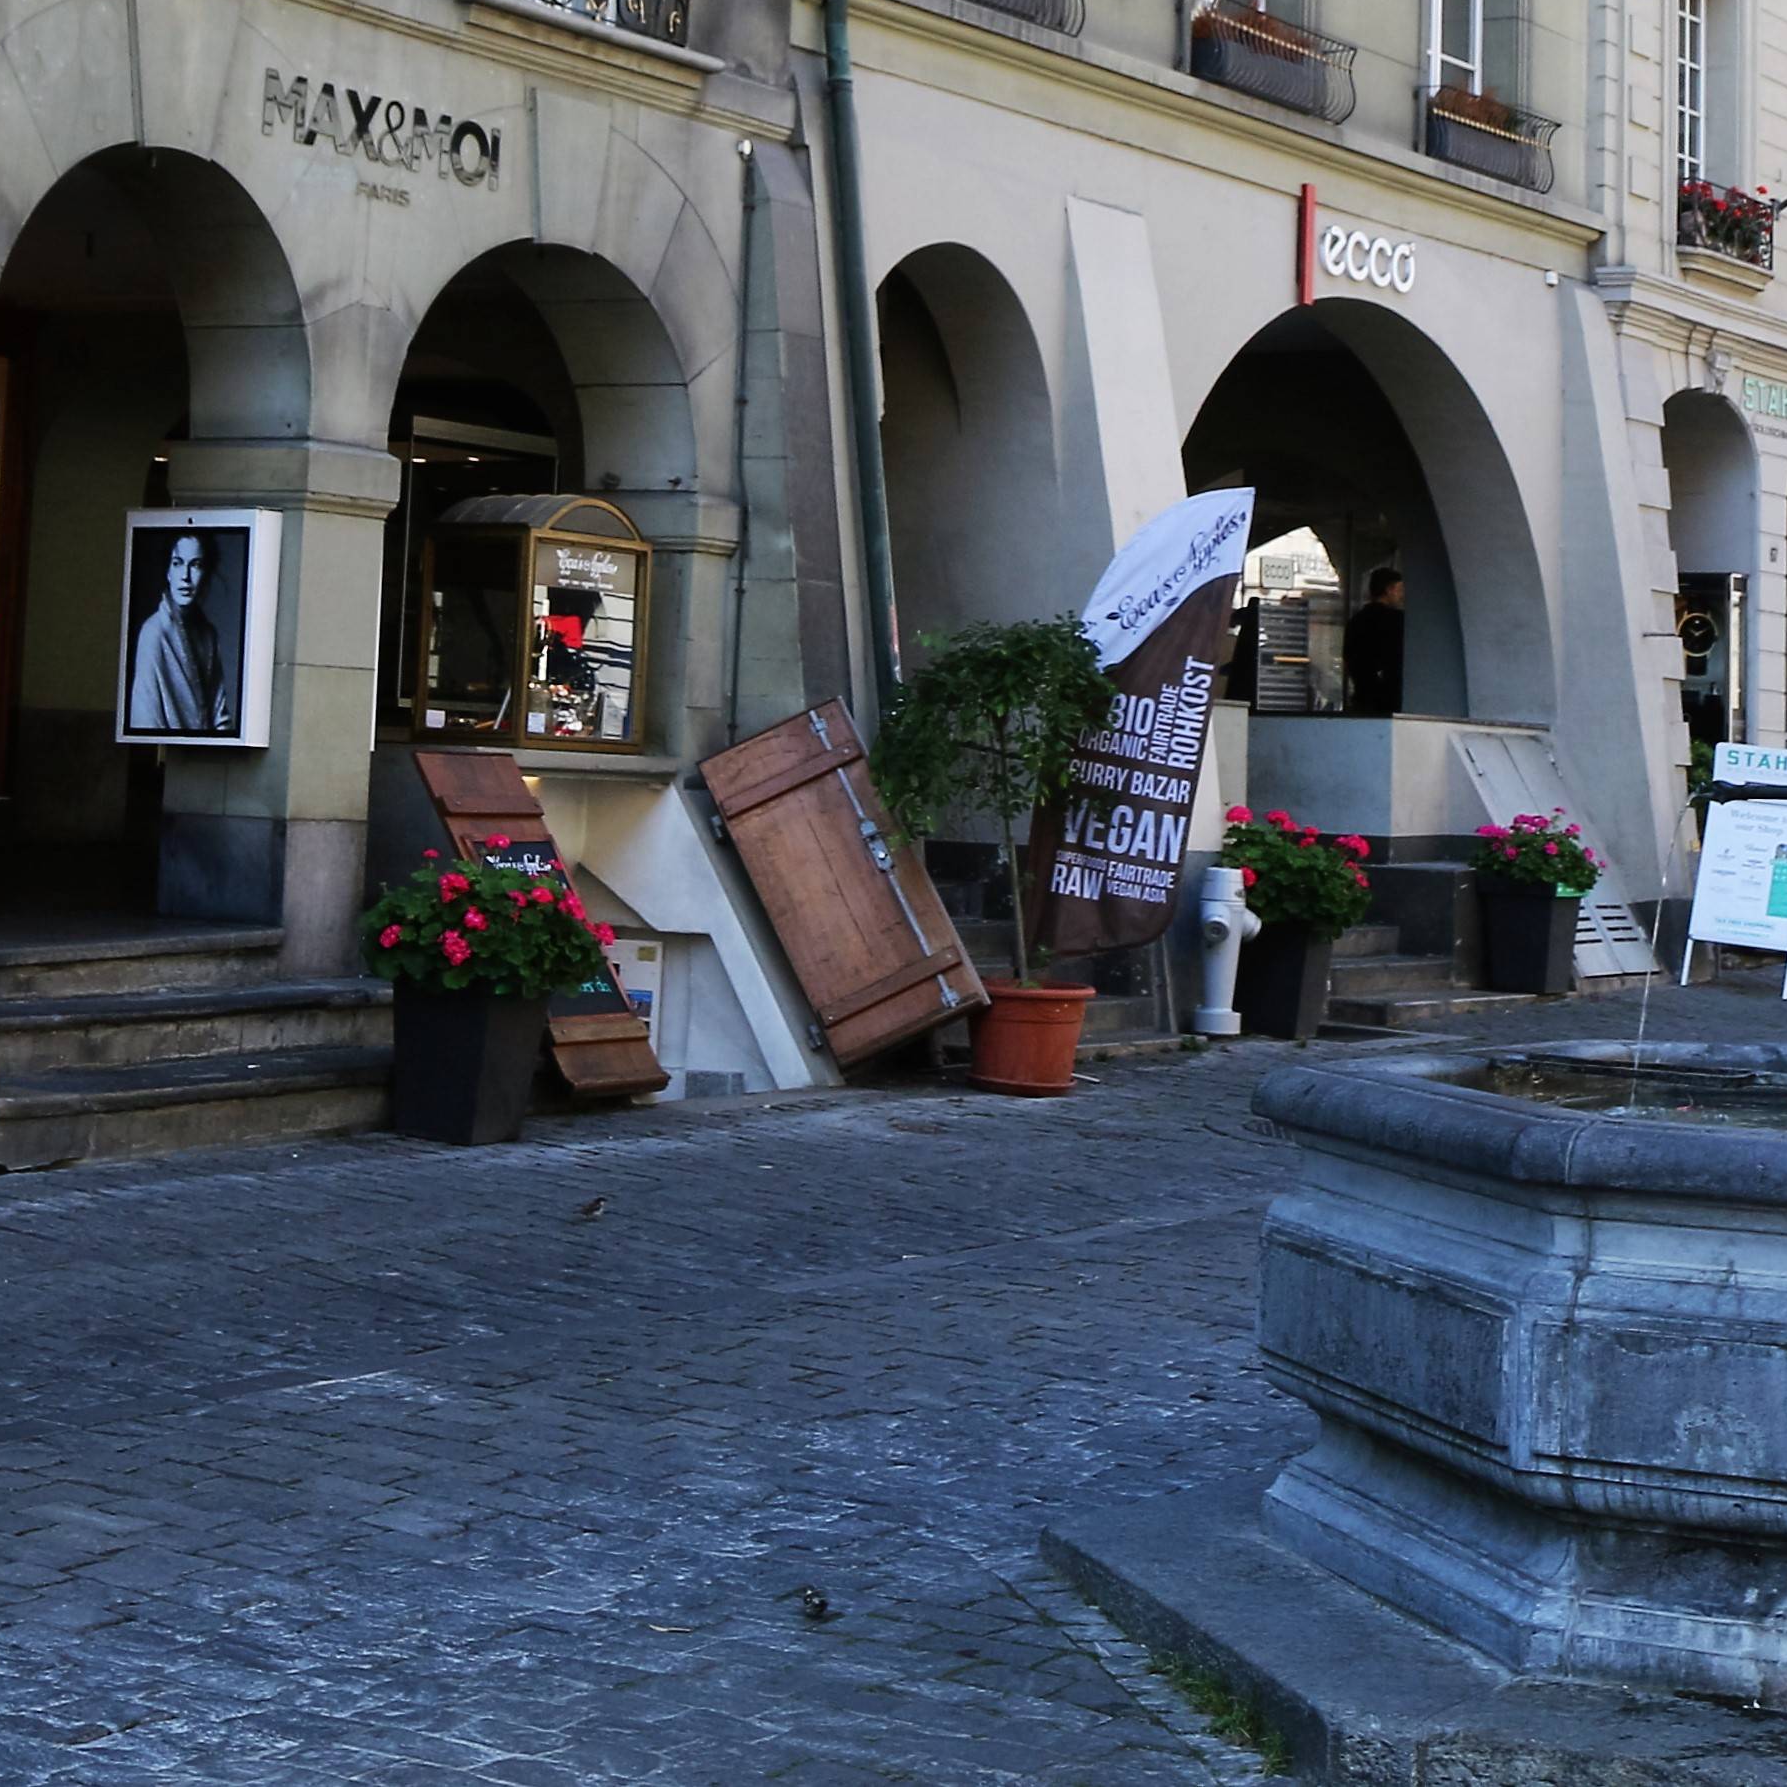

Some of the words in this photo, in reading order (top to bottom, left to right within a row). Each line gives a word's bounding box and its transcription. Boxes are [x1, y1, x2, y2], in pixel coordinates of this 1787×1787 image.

[261, 67, 502, 193] MAX&MOI
[356, 181, 411, 208] PARIS
[1320, 224, 1416, 293] ecco
[1147, 683, 1180, 765] FAIRTRADE
[1167, 655, 1215, 770] ROHKOST
[1078, 725, 1149, 762] ORGANIC
[1130, 771, 1191, 805] BAZAR
[1063, 796, 1187, 864] VEGAN
[1050, 862, 1105, 901] RAW
[1106, 878, 1143, 901] VEGAN
[1142, 882, 1167, 904] ASIA
[1107, 860, 1176, 890] FAIRTRADE
